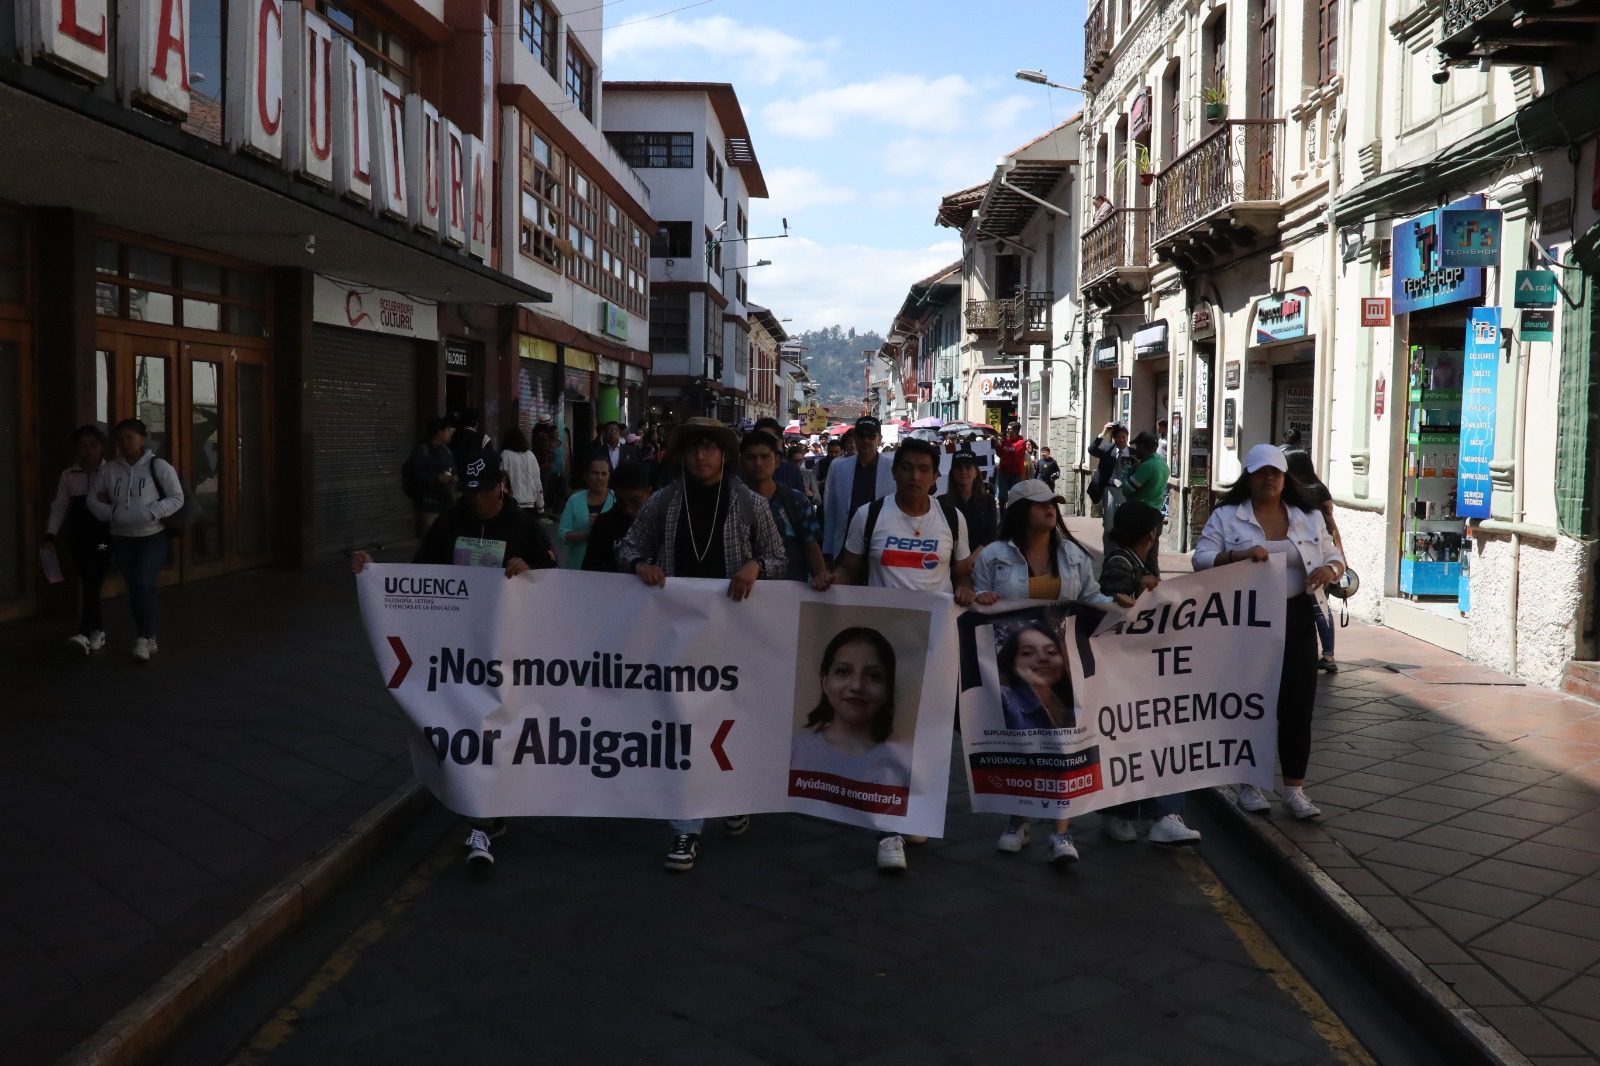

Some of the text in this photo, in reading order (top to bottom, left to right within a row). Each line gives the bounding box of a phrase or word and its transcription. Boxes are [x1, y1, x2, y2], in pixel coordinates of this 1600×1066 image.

[1536, 283, 1552, 292] caja
[380, 310, 413, 330] CULTURAL
[885, 536, 938, 552] PEPSI
[385, 577, 469, 596] UCUENCA
[427, 648, 738, 692] ¡Nos movilizamos
[1152, 646, 1192, 675] TE
[1098, 693, 1264, 740] QUEREMOS
[512, 717, 692, 778] Abigail!
[1110, 739, 1256, 787] DE VUELTA
[795, 777, 902, 805] Ayúdanos a encontrarla
[1006, 778, 1032, 787] 1800
